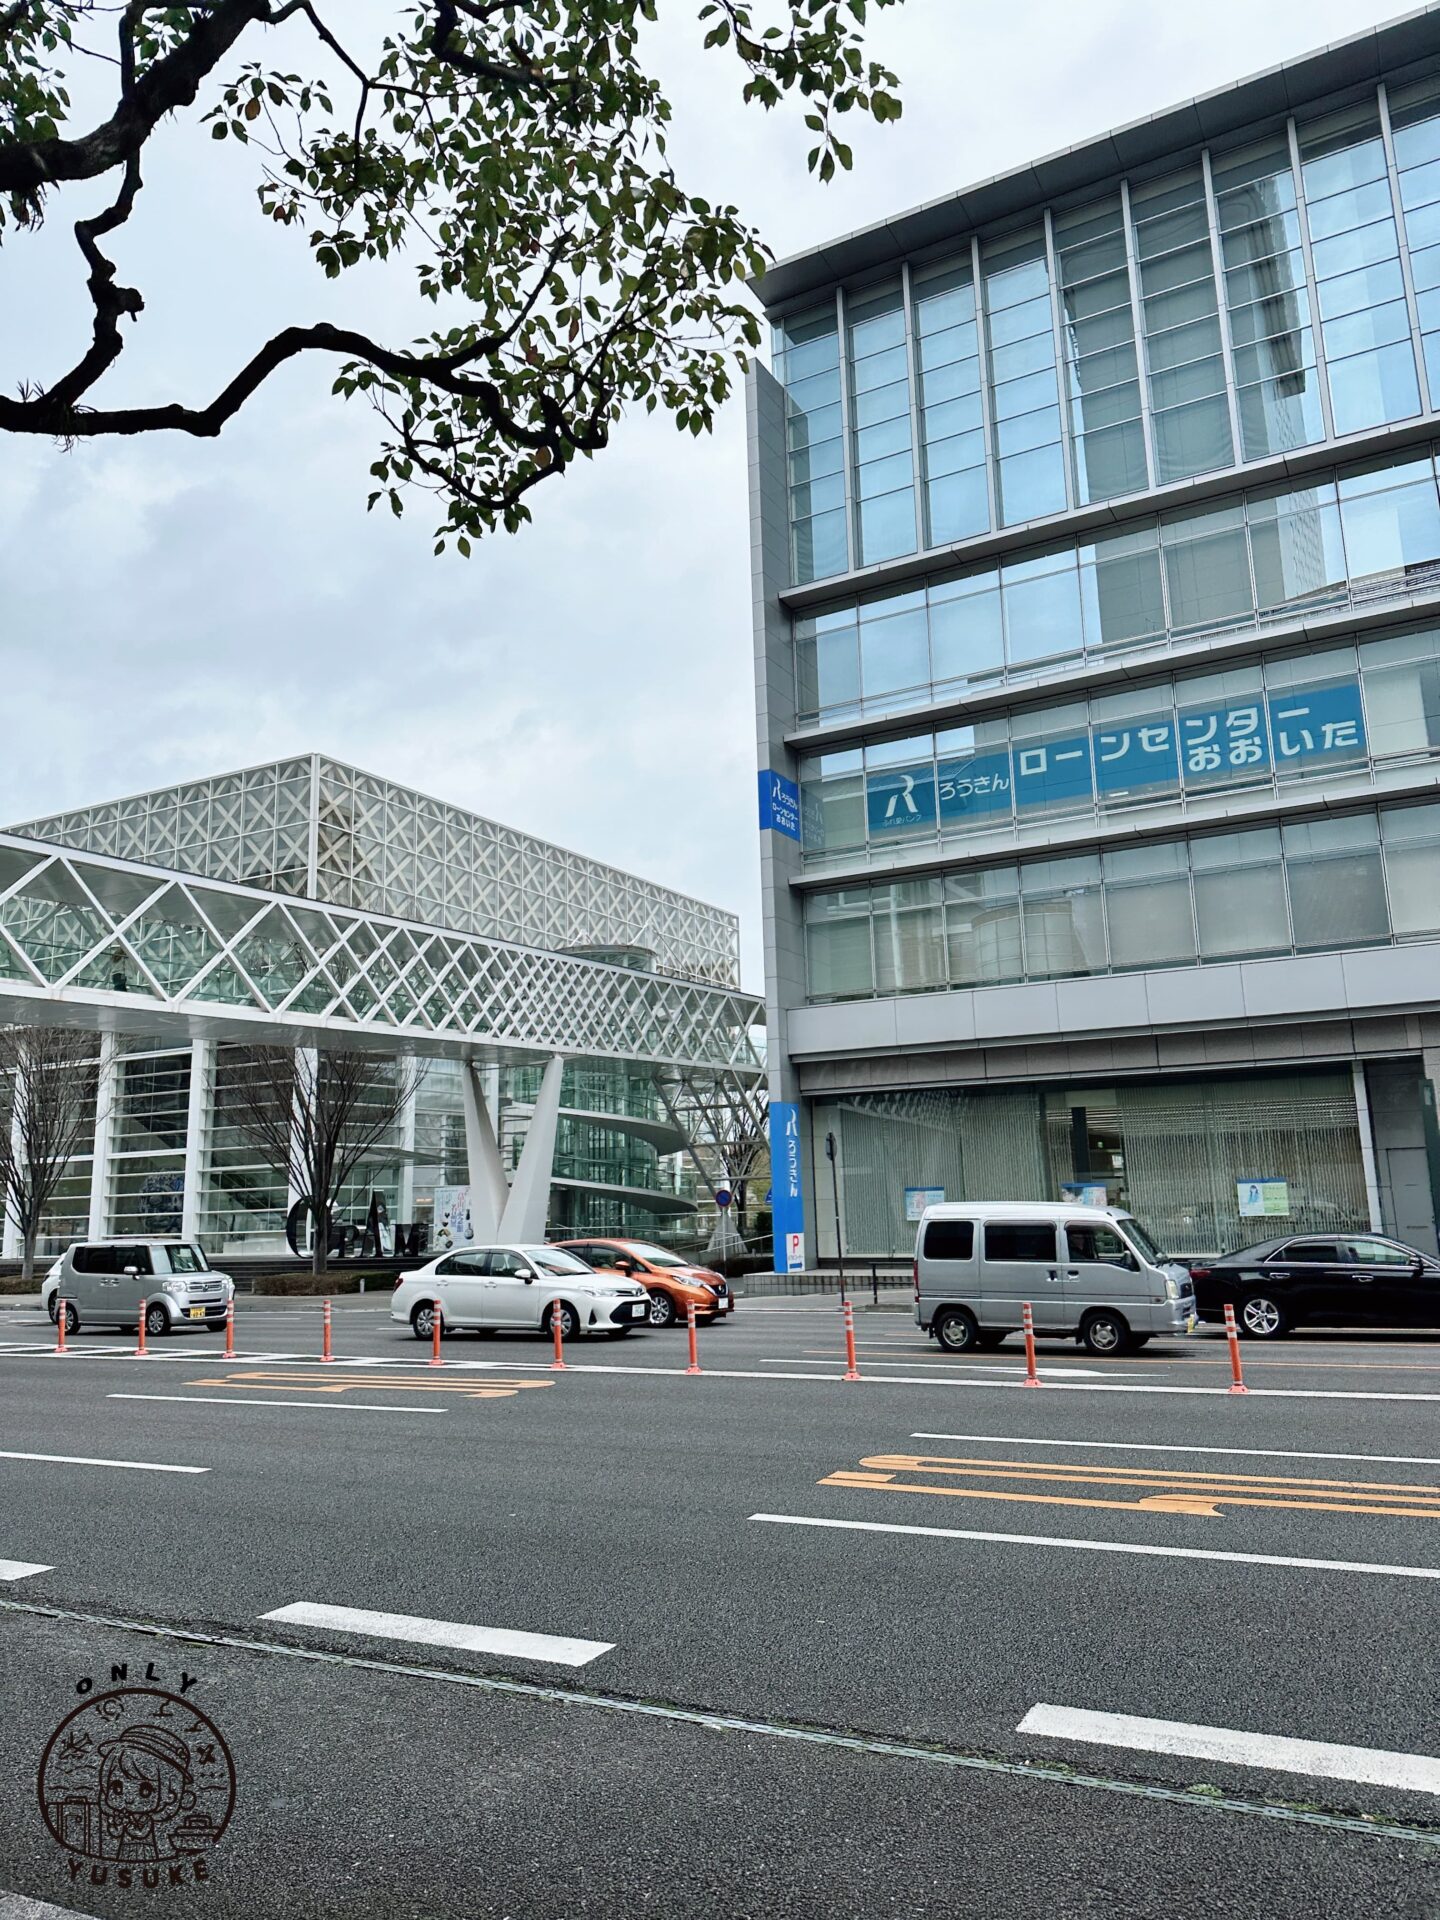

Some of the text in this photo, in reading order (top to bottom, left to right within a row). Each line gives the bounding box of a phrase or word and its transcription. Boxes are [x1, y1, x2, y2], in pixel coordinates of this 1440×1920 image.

[940, 773, 1010, 800] ろうきん
[1020, 707, 1310, 775] ローンセンター
[1188, 720, 1359, 772] おおいた
[788, 1140, 798, 1197] ろうきん
[793, 1235, 799, 1254] P
